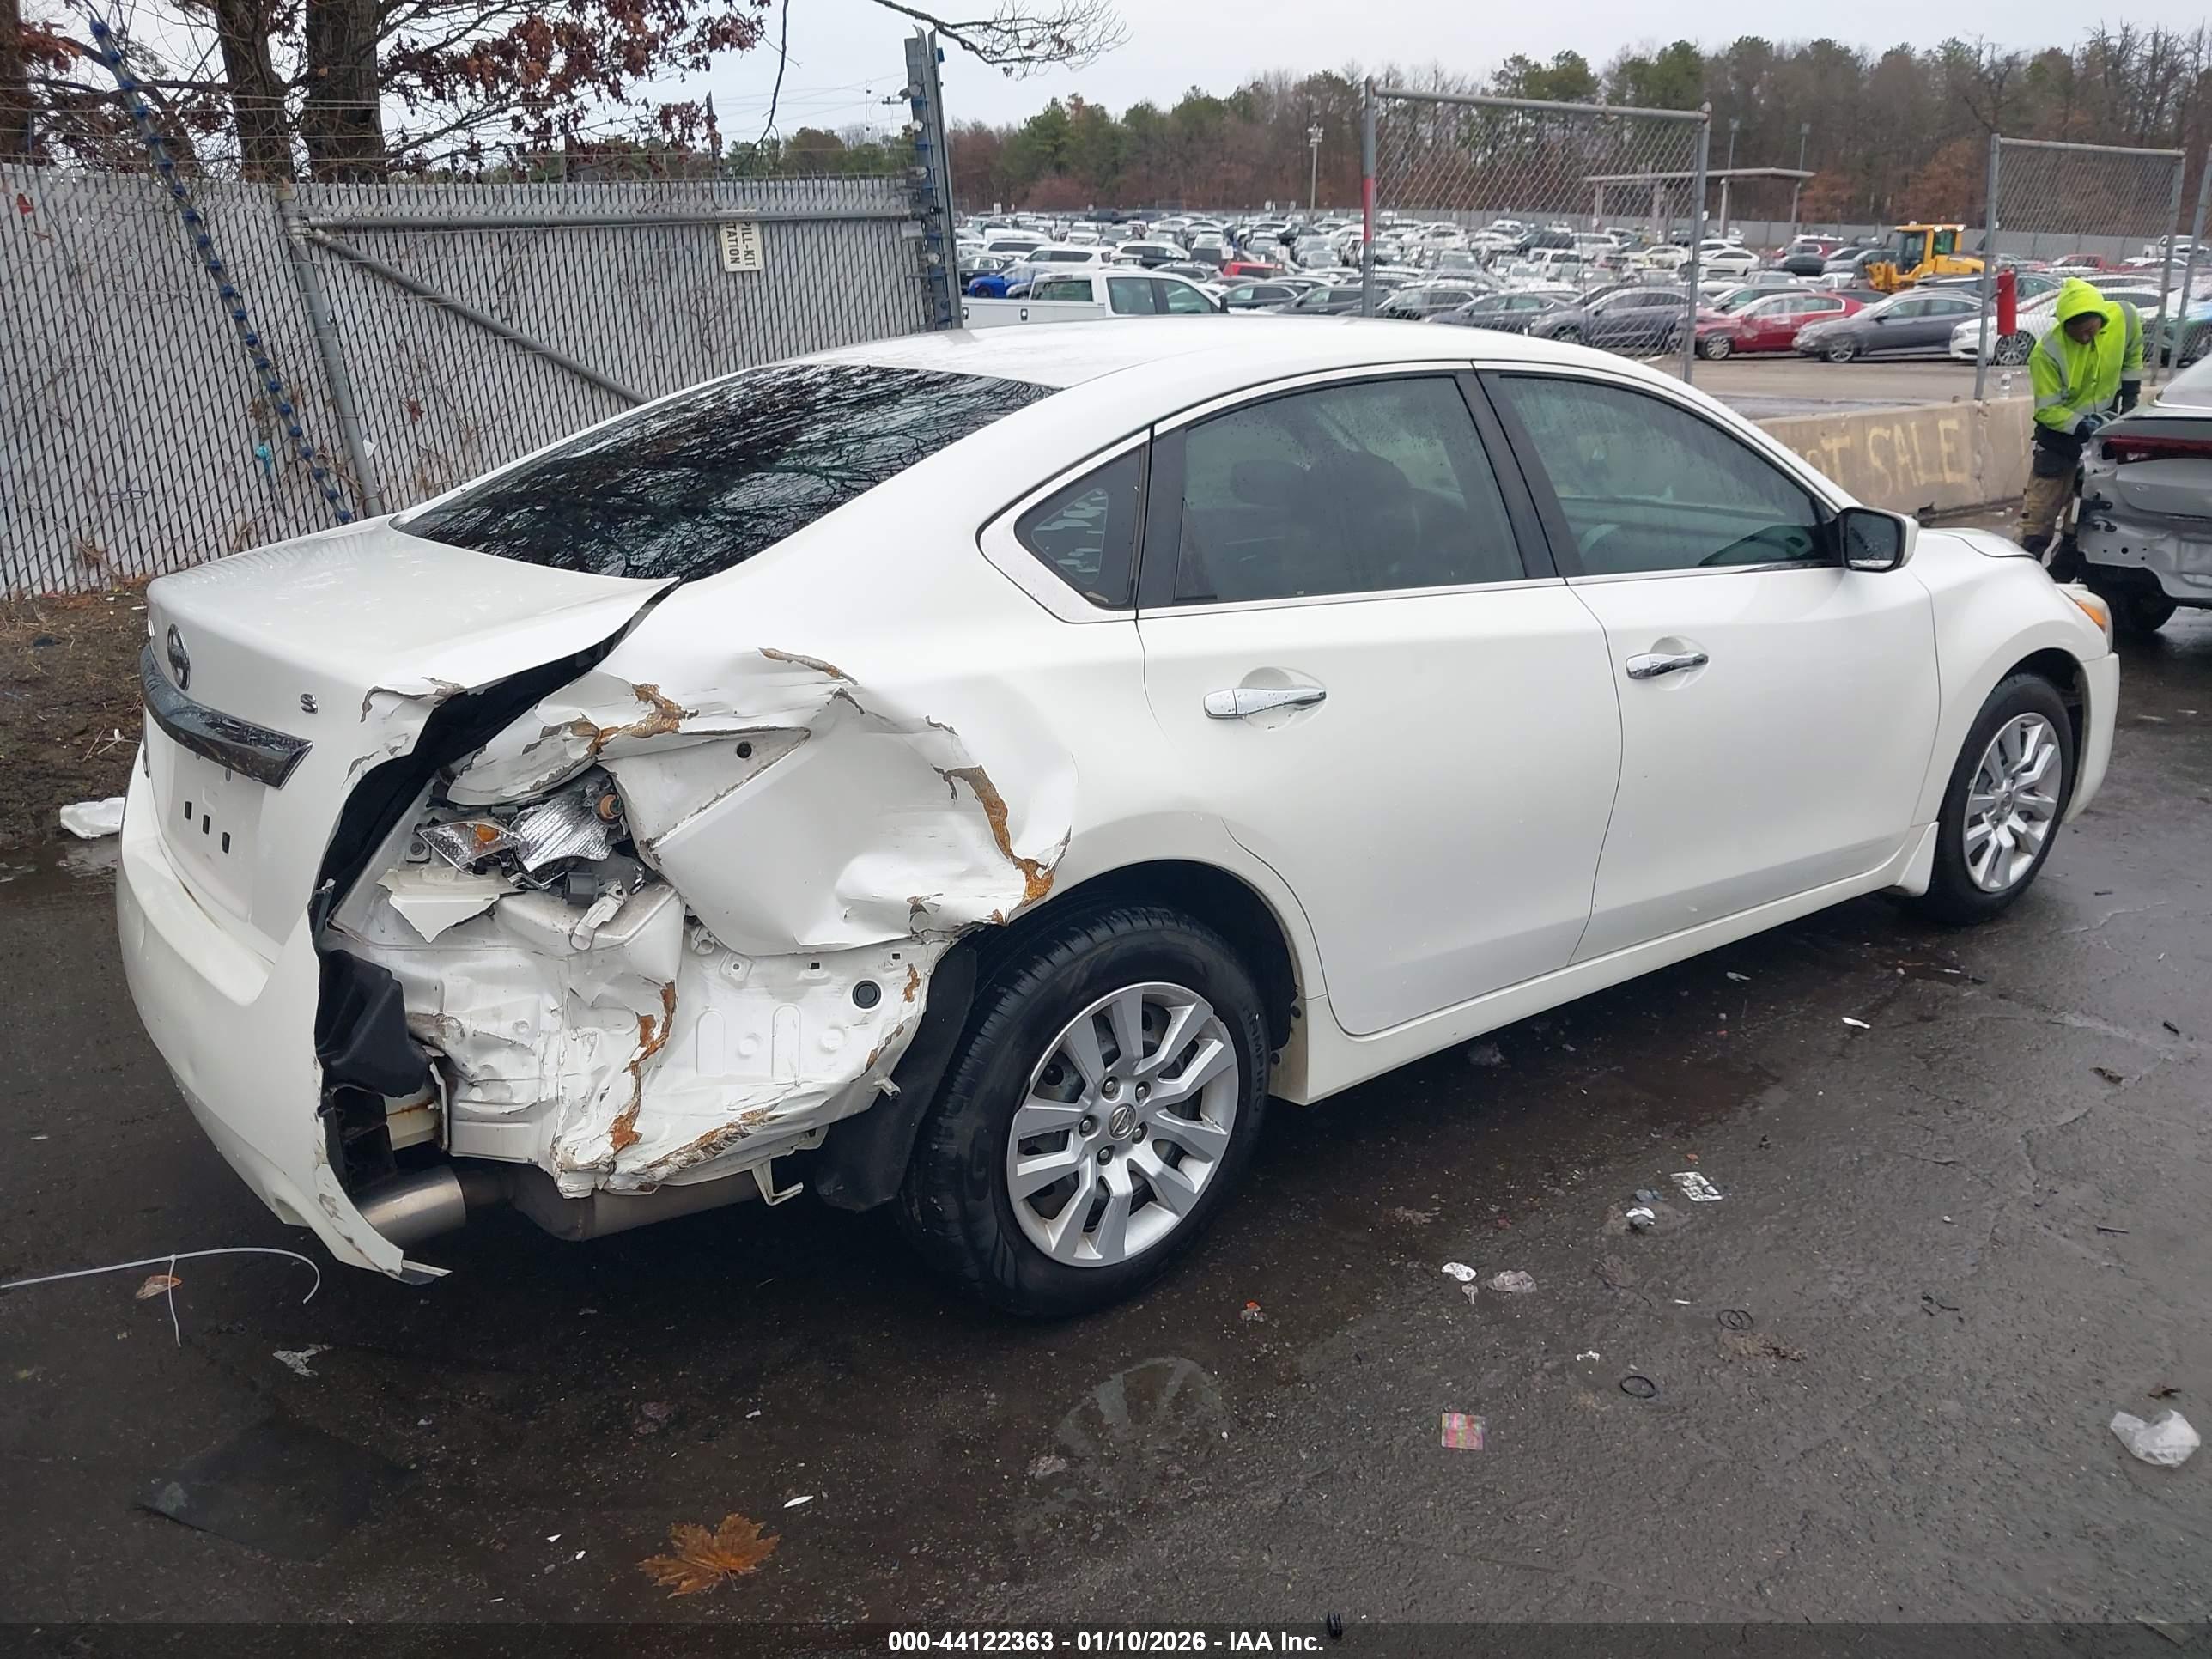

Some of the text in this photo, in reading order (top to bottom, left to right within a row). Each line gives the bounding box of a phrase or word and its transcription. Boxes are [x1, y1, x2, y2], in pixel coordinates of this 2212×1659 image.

[726, 221, 741, 265] TATION
[741, 221, 757, 268] PILL-KIT
[1867, 418, 1968, 499] SALE
[300, 692, 319, 715] S
